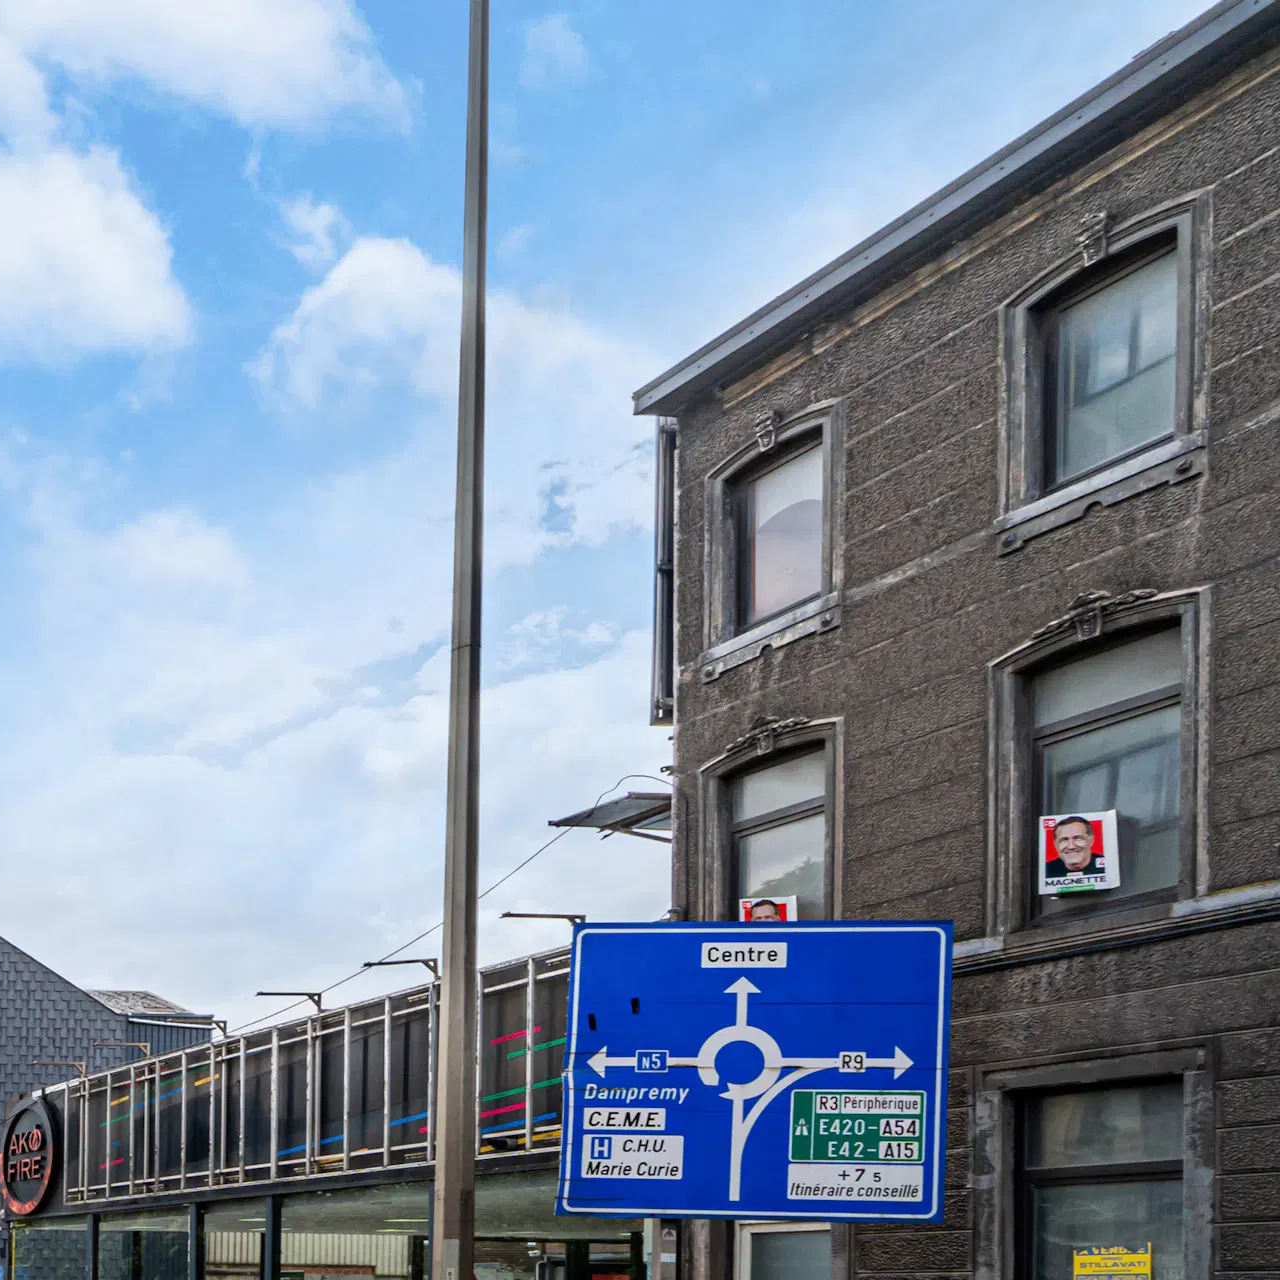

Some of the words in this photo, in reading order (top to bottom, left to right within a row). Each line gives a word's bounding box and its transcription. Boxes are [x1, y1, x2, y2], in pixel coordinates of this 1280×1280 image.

[1045, 876, 1107, 887] MAGNETTE
[707, 947, 778, 963] Centre
[642, 1054, 660, 1069] N5
[842, 1055, 864, 1070] R9
[584, 1083, 689, 1104] Dampremy
[819, 1096, 838, 1111] R3
[844, 1097, 919, 1113] Périphérique
[588, 1112, 661, 1128] C.E.M.E.
[593, 1139, 609, 1158] H
[622, 1139, 667, 1153] C.H.U.
[7, 1156, 41, 1183] FIRE
[585, 1161, 632, 1176] Marie
[636, 1162, 679, 1177] Curie
[790, 1182, 854, 1197] Itinéraire
[857, 1184, 919, 1198] conseillé
[1092, 1246, 1146, 1254] VENDE
[1080, 1261, 1147, 1269] STILLAVATI
